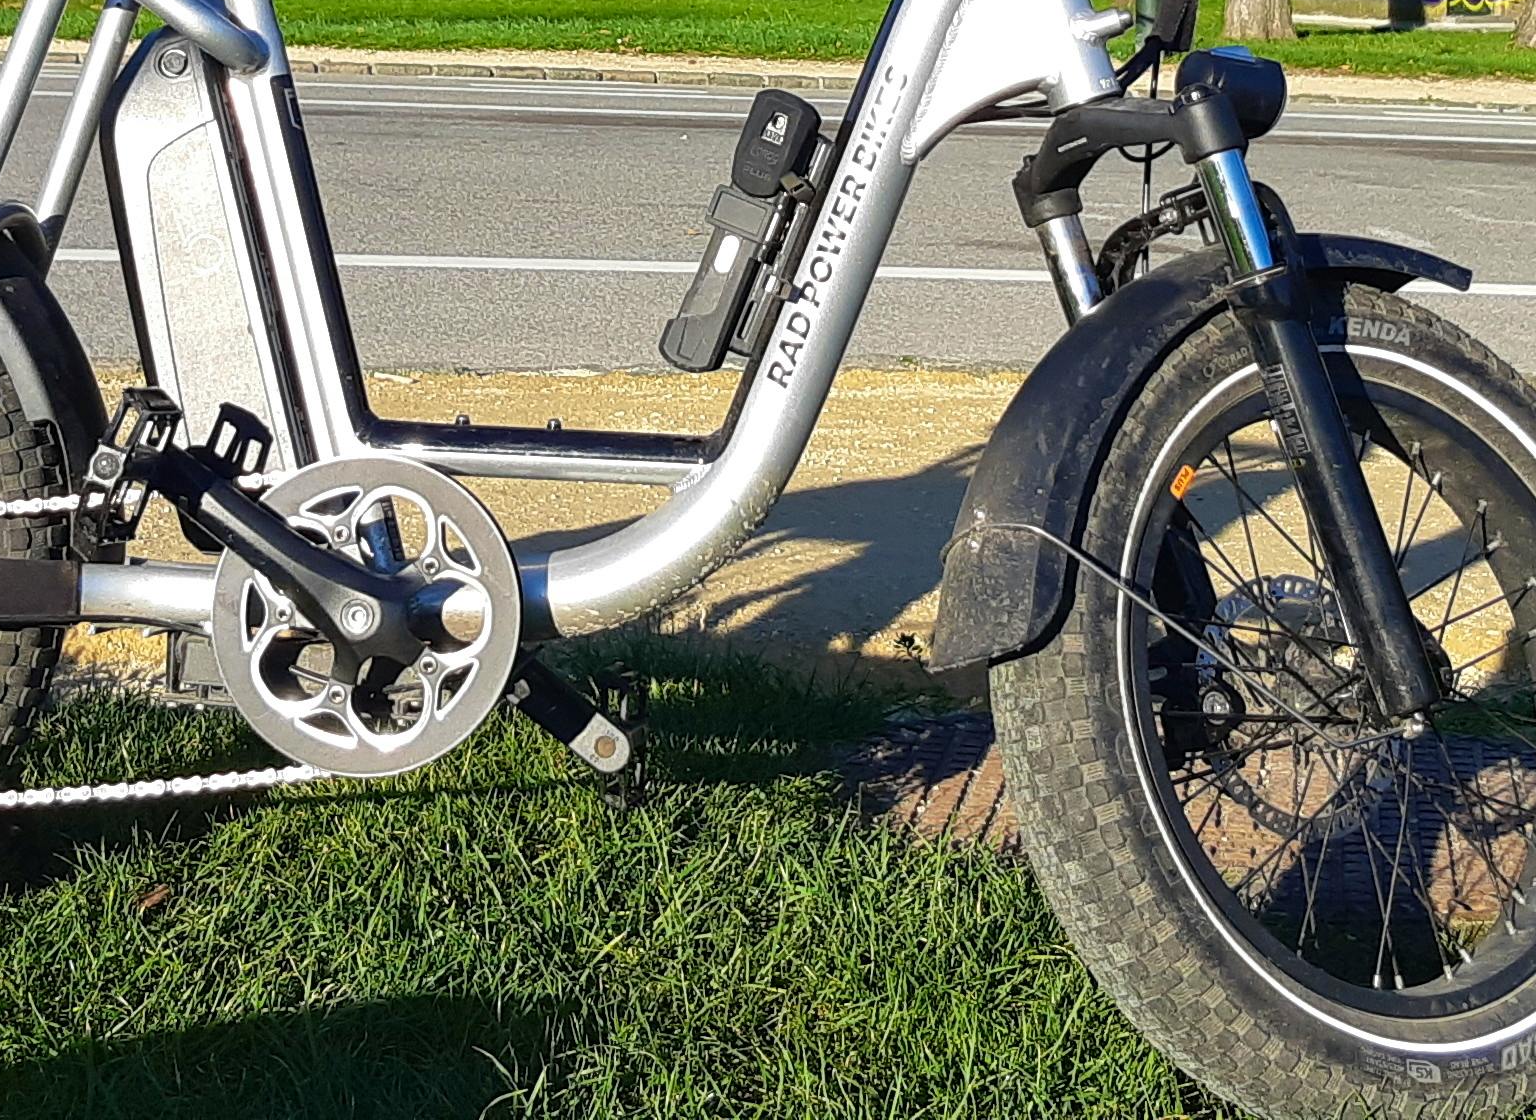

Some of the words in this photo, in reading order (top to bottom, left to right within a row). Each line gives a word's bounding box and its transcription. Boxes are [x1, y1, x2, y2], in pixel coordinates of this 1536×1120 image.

[766, 310, 812, 389] RAD
[802, 173, 867, 309] POWER
[852, 64, 908, 173] BIKES
[1328, 315, 1412, 347] KENDA
